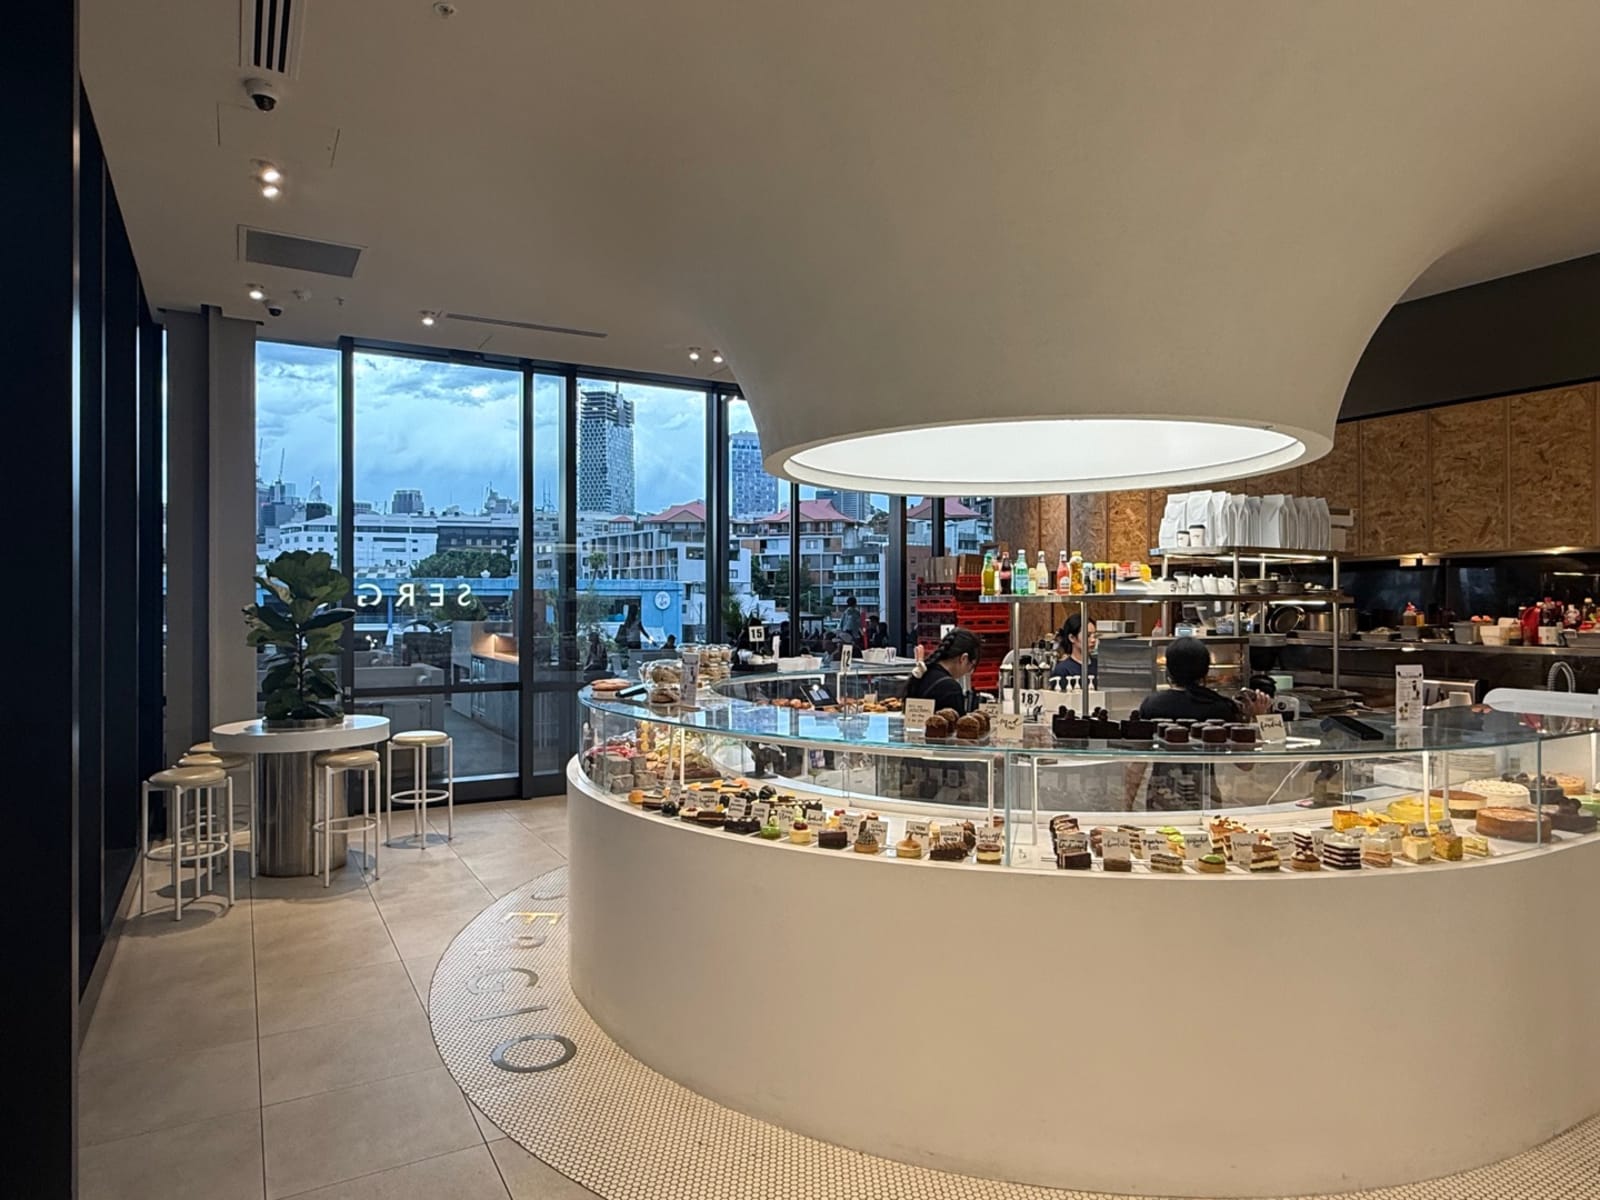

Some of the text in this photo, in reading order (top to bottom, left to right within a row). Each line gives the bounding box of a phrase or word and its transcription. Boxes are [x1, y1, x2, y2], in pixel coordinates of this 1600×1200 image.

[750, 628, 763, 639] 15
[842, 648, 852, 668] 12
[1021, 692, 1040, 706] 187
